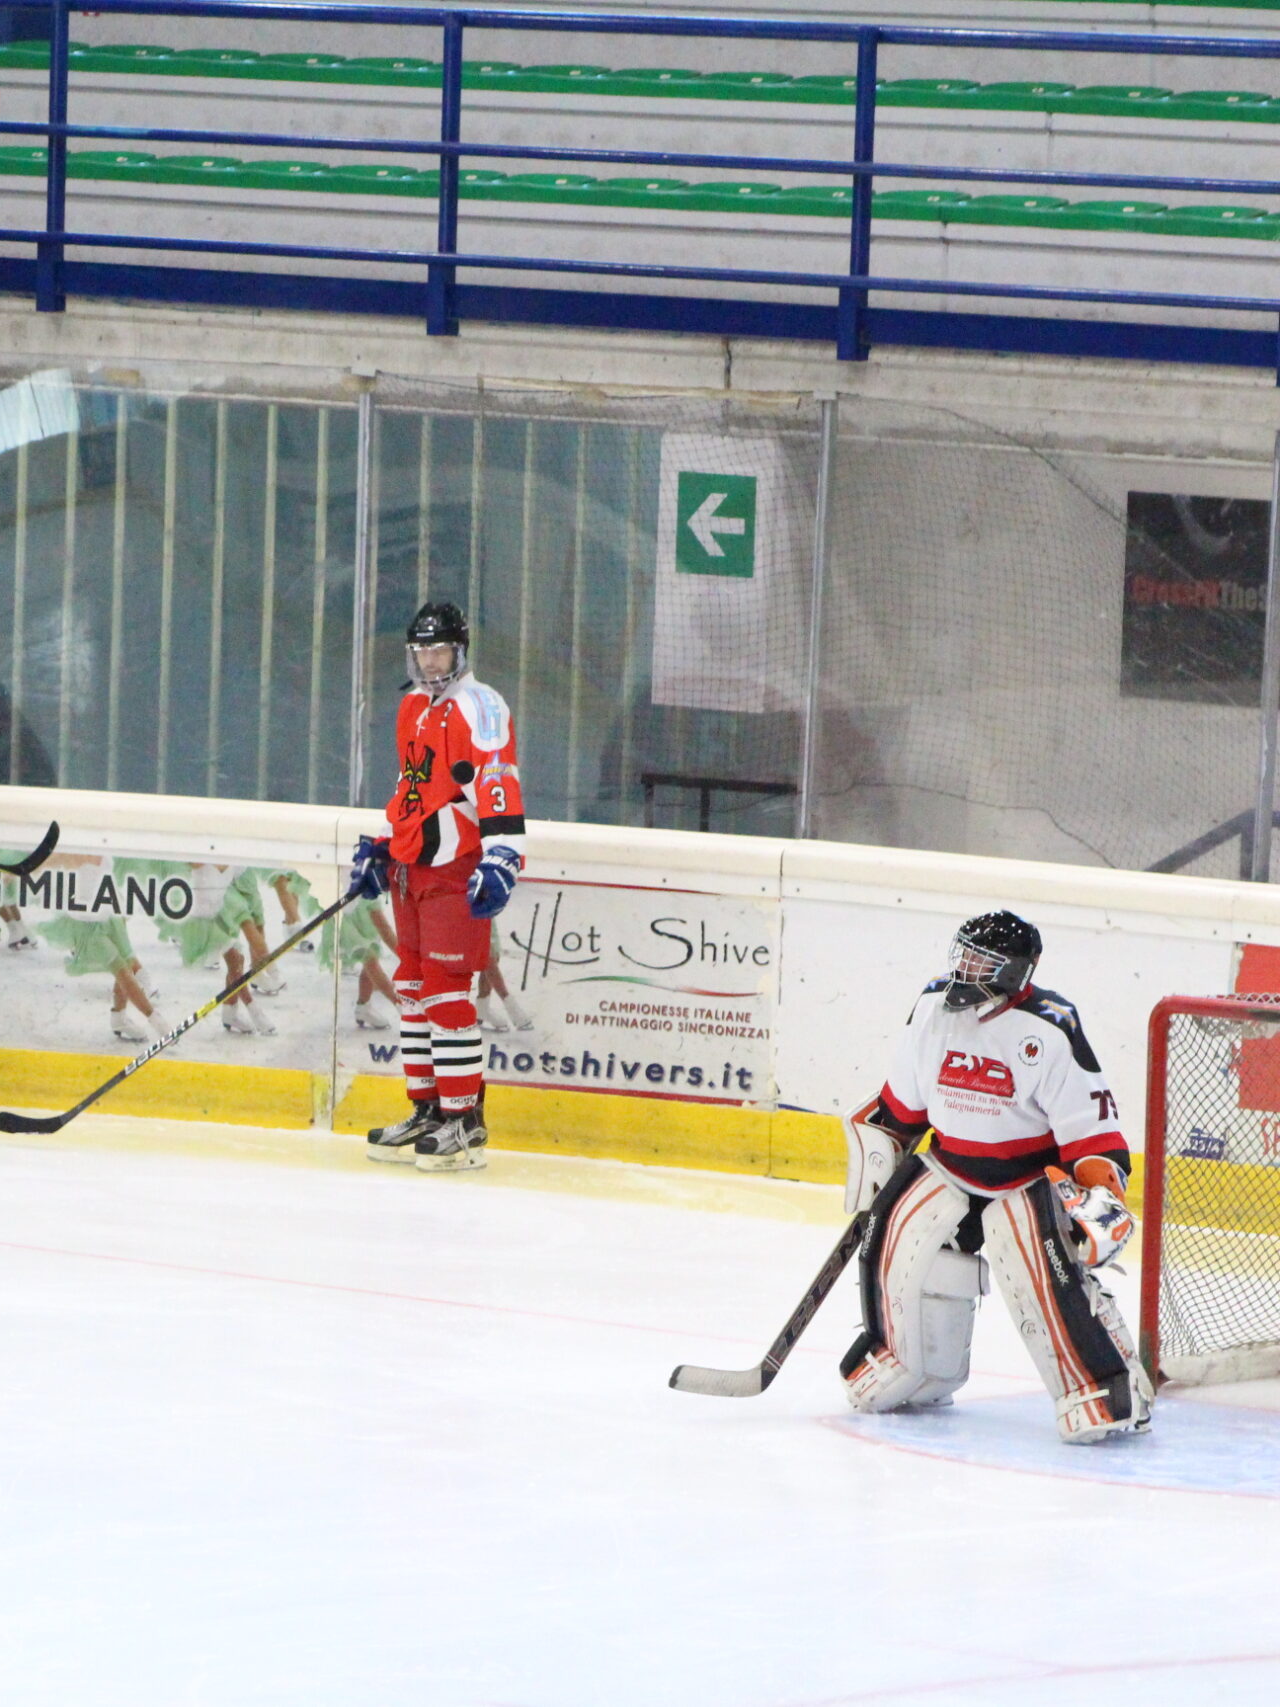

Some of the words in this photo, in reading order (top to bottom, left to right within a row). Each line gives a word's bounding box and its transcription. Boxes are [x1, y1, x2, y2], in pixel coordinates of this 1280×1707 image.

[490, 785, 507, 813] 3
[20, 870, 194, 920] MILANO
[509, 891, 602, 992] Hot
[618, 917, 771, 970] Shive
[565, 1012, 579, 1024] DI
[583, 1013, 673, 1032] PATTINAGGIO
[598, 999, 690, 1019] CAMPIONESSE
[693, 1007, 752, 1024] ITALIANE
[1043, 1238, 1069, 1287] Reebok
